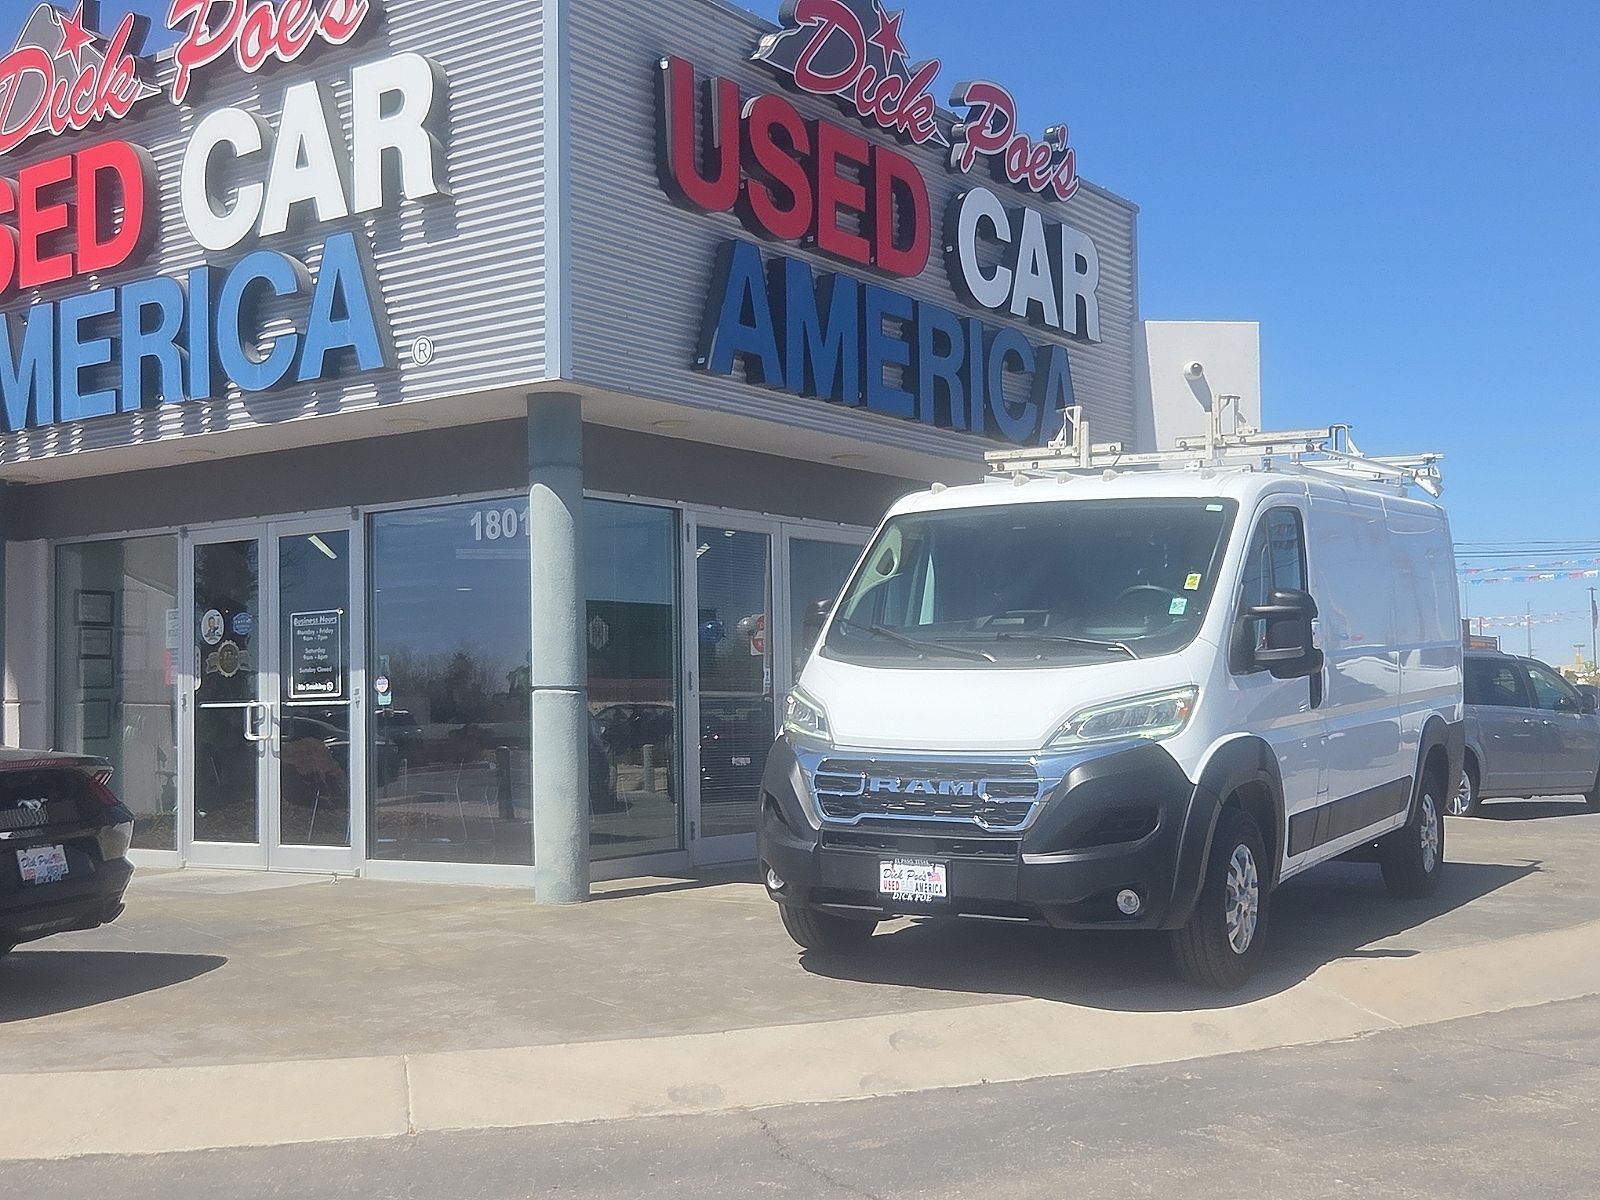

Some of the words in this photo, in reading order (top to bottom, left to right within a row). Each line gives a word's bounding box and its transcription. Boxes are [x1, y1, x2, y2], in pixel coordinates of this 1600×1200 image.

[793, 0, 941, 145] Dick
[961, 80, 1079, 202] Poe's
[0, 140, 144, 294] ED
[181, 52, 440, 251] CAR
[666, 56, 932, 279] USED
[957, 186, 1102, 344] CAR
[707, 239, 1076, 449] AMERICA
[470, 506, 530, 541] 1801
[869, 777, 975, 797] RAM
[883, 868, 904, 880] Dick
[883, 880, 900, 891] USED
[914, 882, 943, 894] AMERICA
[892, 892, 913, 901] DICK
